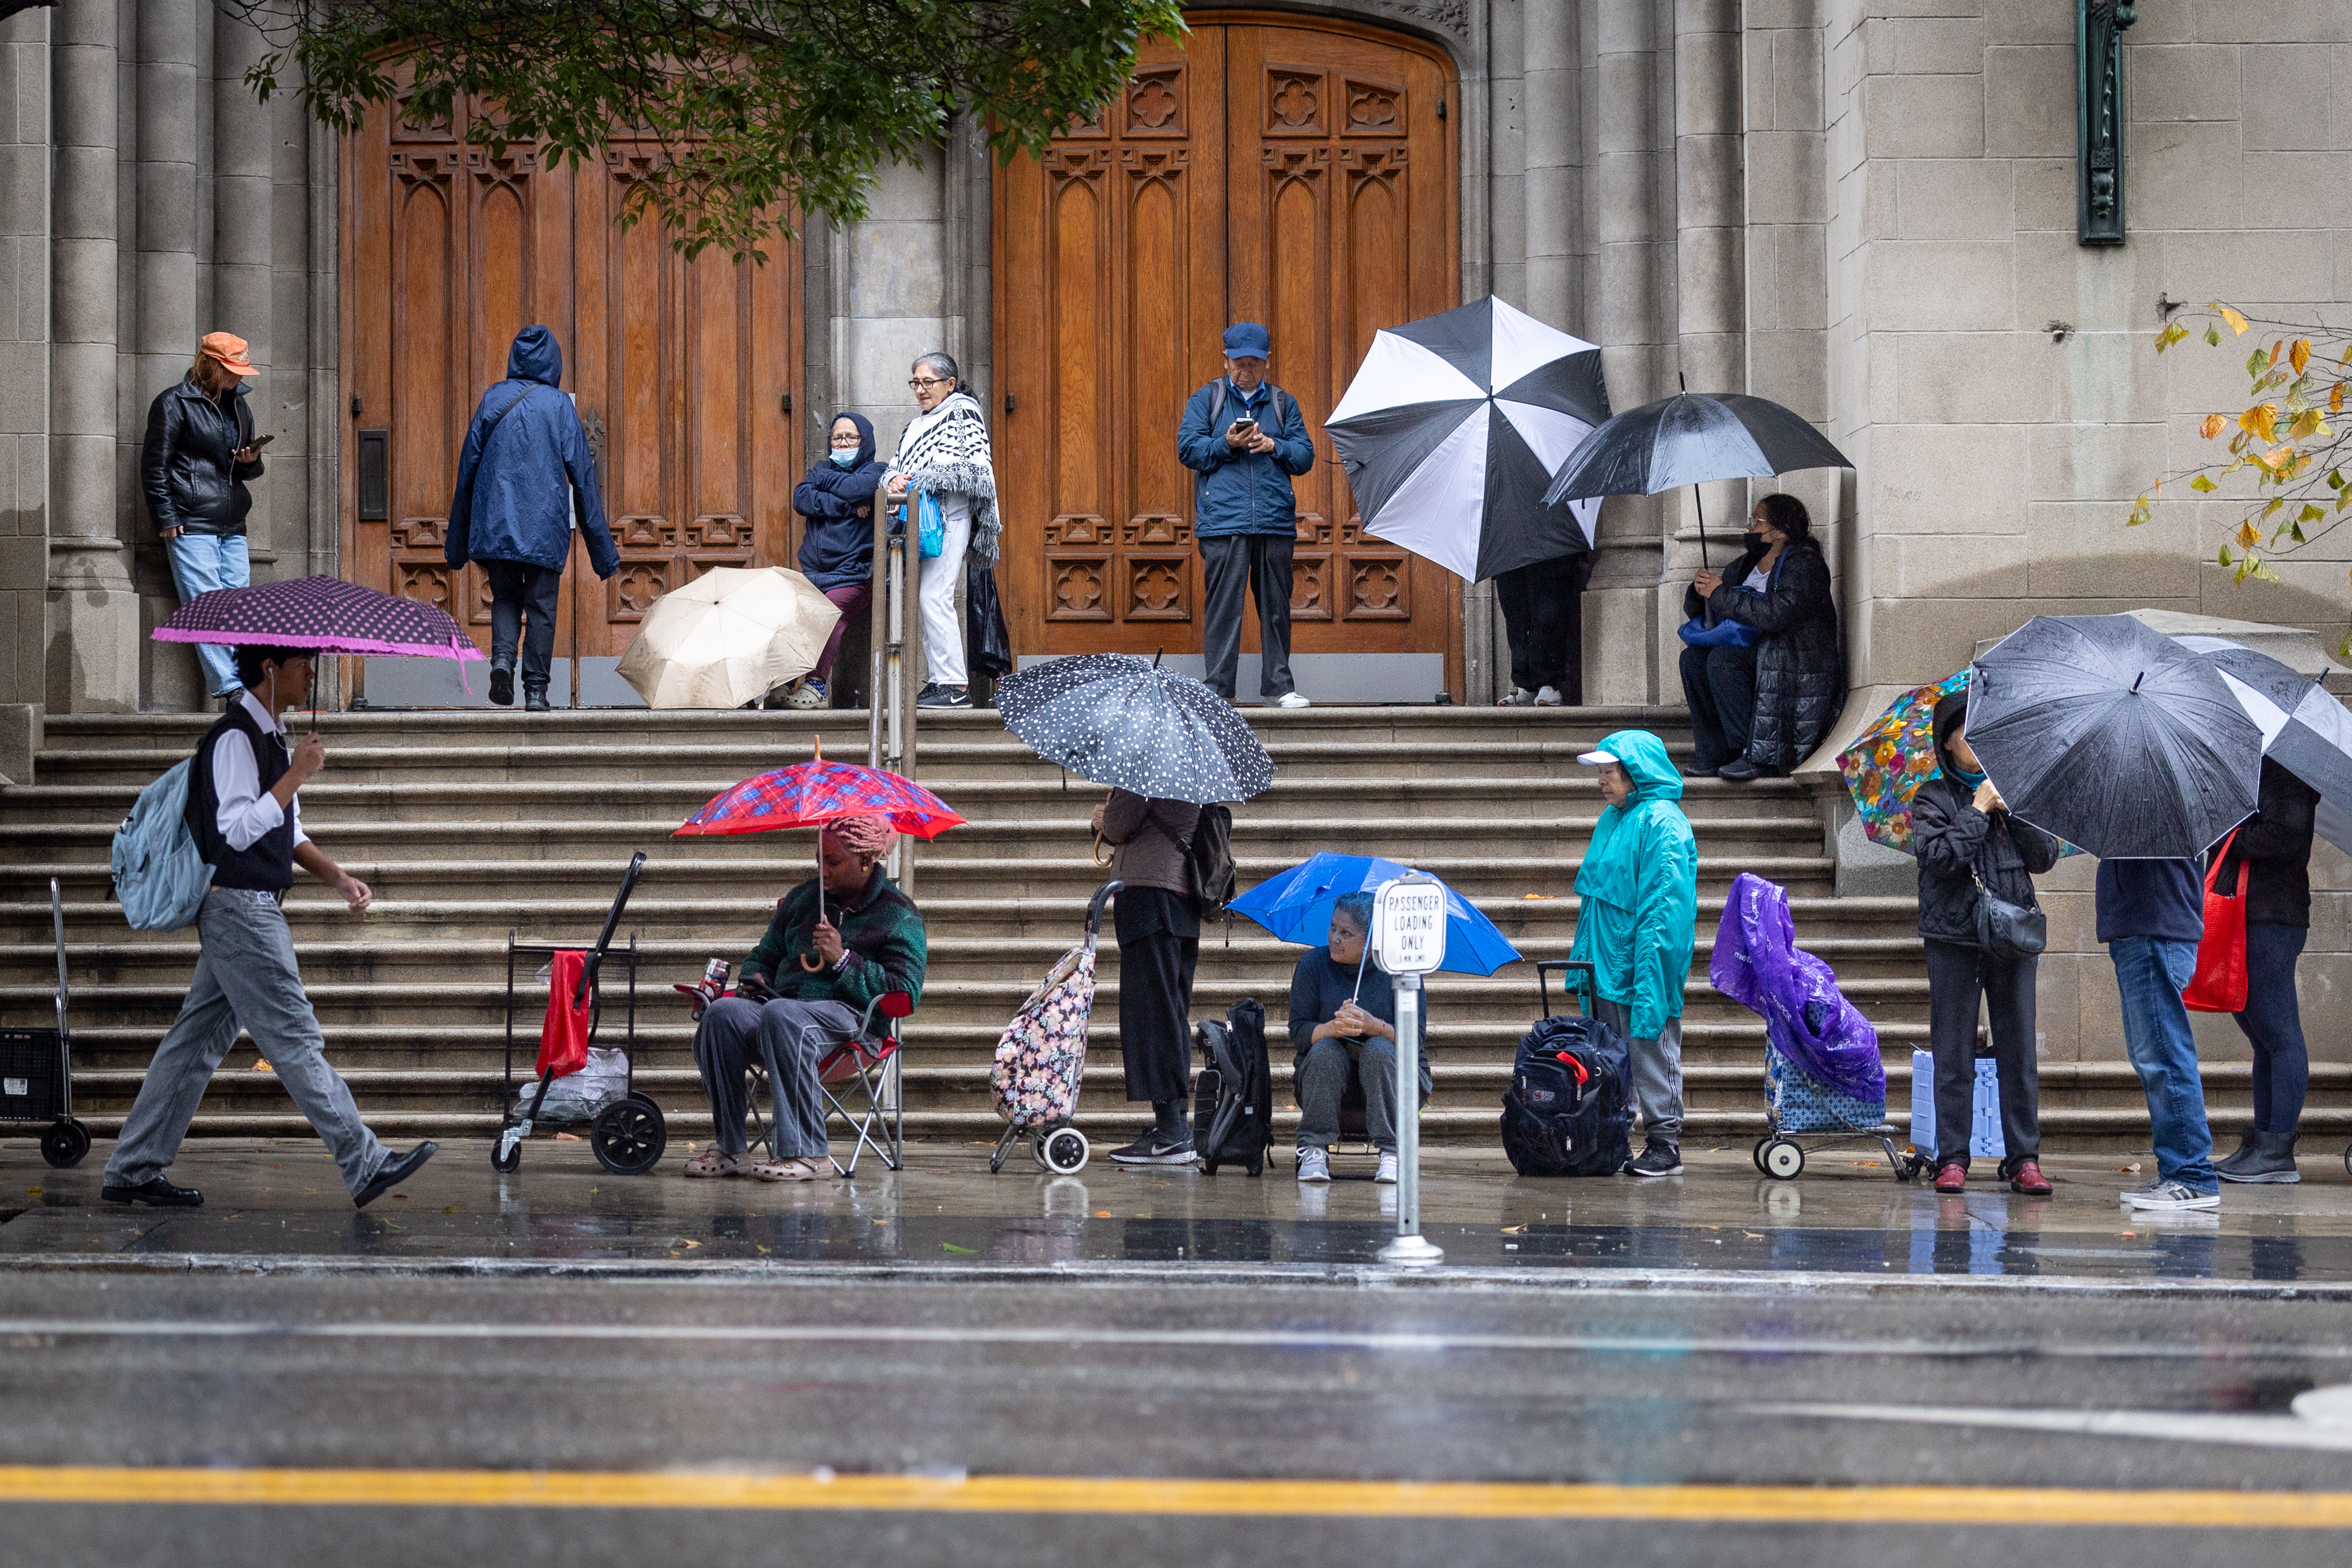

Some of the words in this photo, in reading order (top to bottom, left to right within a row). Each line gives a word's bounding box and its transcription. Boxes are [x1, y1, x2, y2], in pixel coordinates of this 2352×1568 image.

[1389, 896, 1439, 911] PASSENGER
[1394, 916, 1432, 931] LOADING
[1401, 935, 1424, 950] ONLY
[1398, 955, 1402, 963] 5
